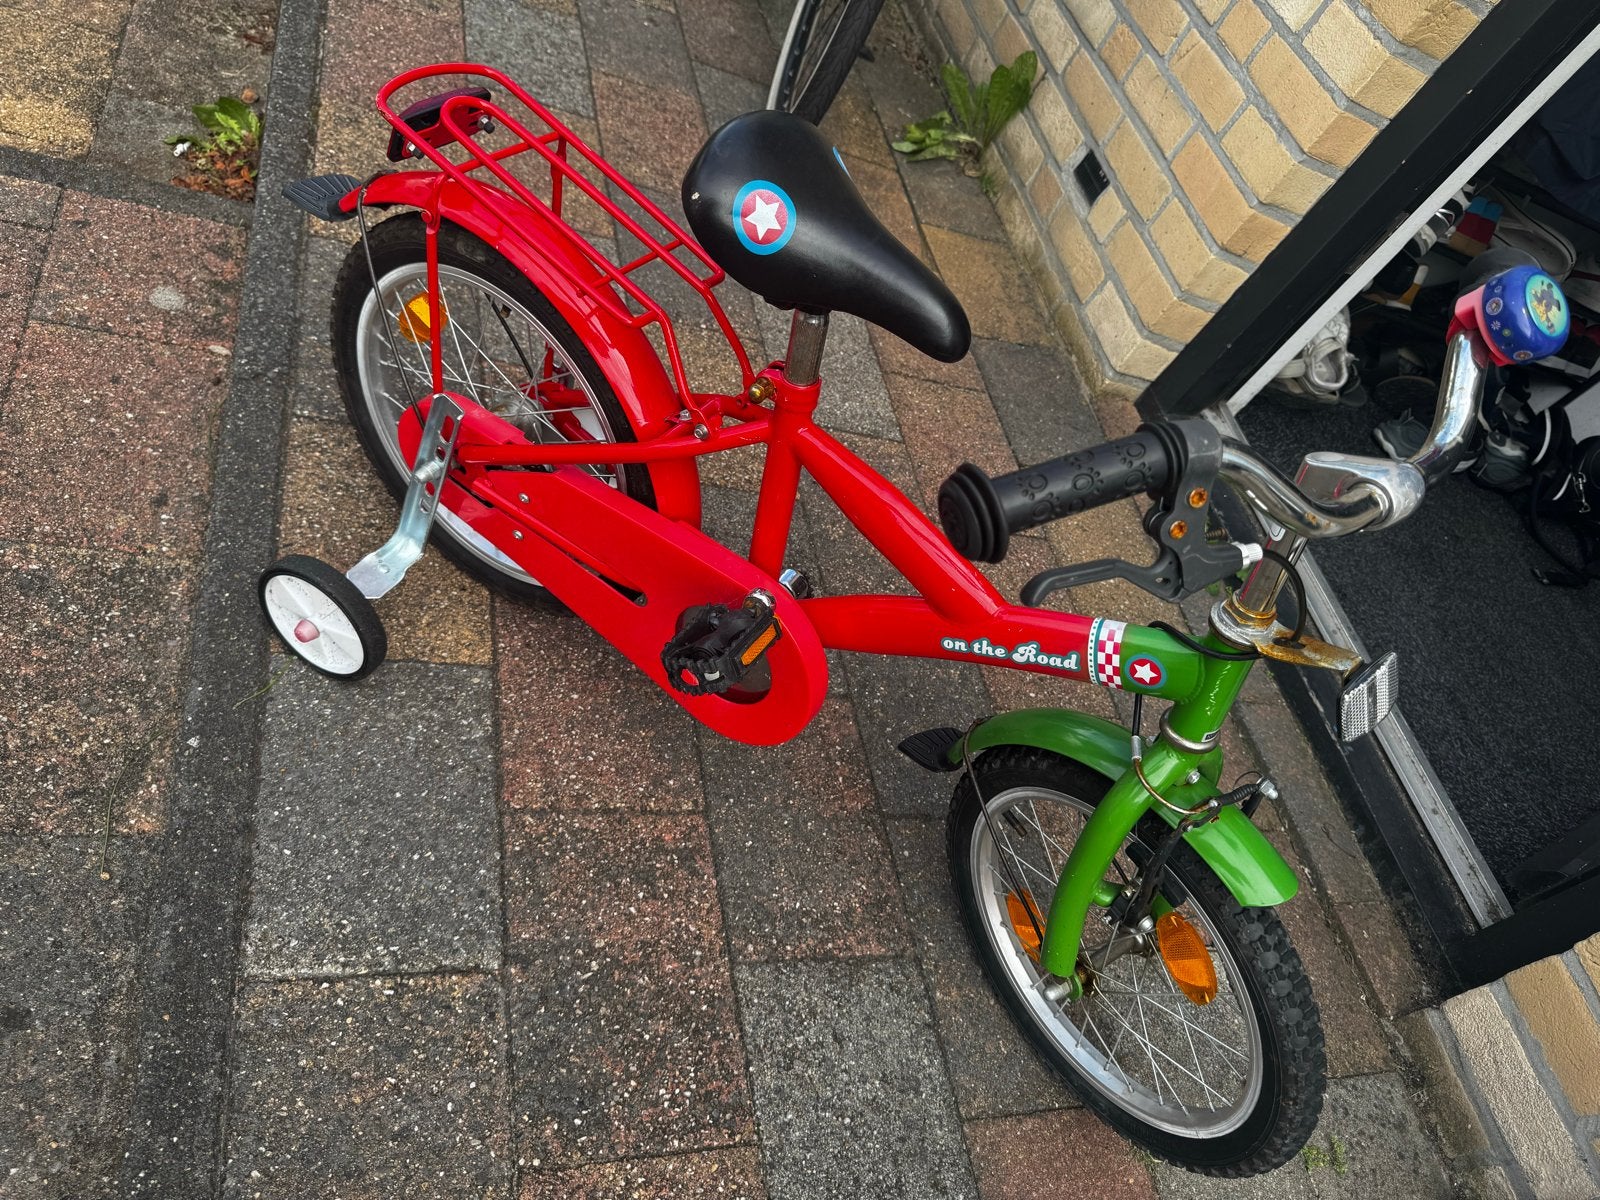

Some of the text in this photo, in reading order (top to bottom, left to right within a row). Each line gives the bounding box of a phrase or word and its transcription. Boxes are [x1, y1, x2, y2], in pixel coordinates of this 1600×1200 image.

[942, 638, 1079, 670] on the Road
